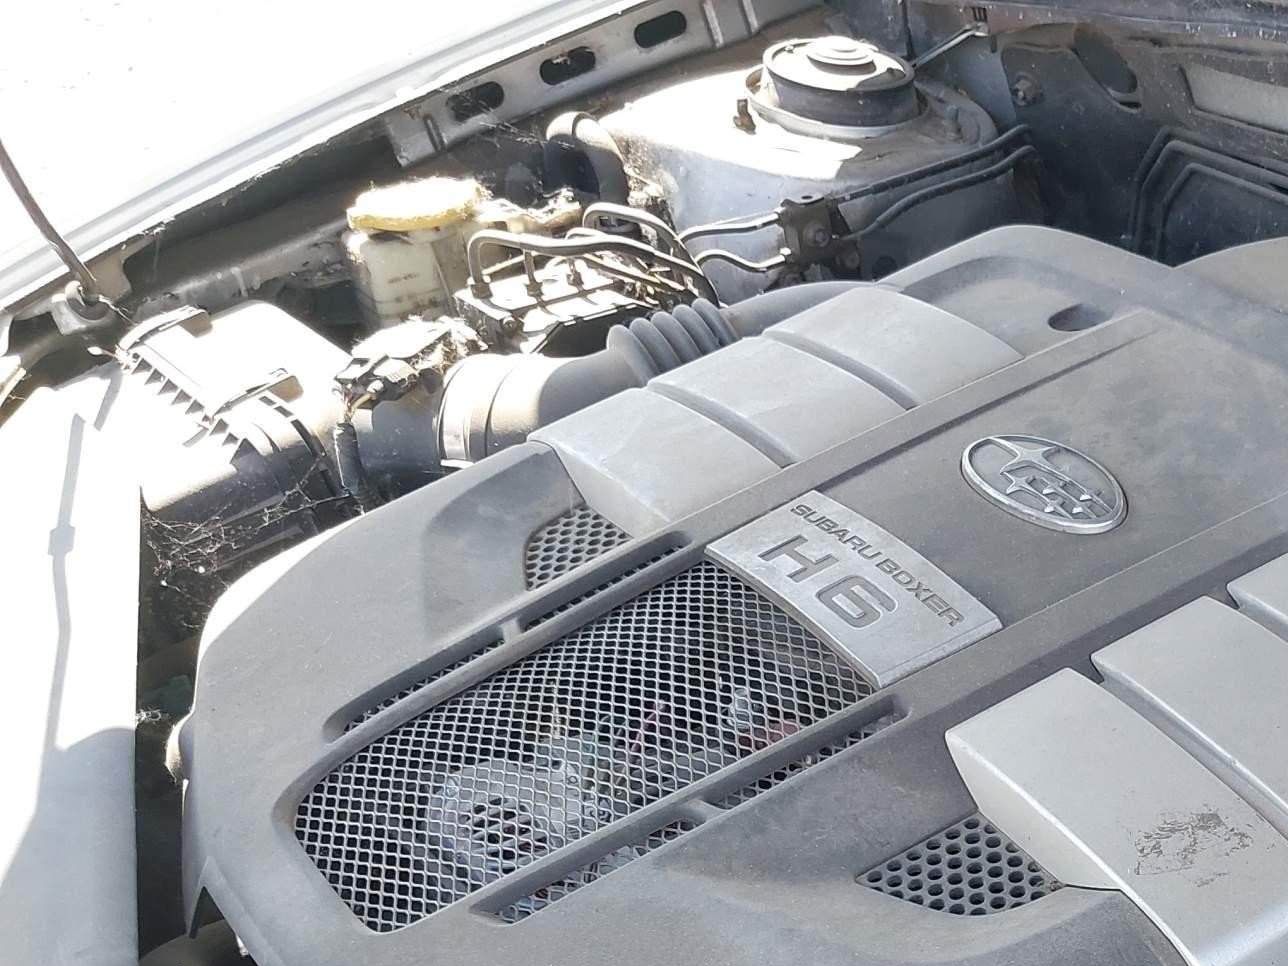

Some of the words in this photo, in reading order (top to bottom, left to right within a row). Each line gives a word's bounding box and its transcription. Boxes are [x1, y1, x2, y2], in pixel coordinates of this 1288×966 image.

[758, 533, 897, 628] H6
[790, 504, 882, 559] SUBARU
[876, 559, 967, 627] BOXER
